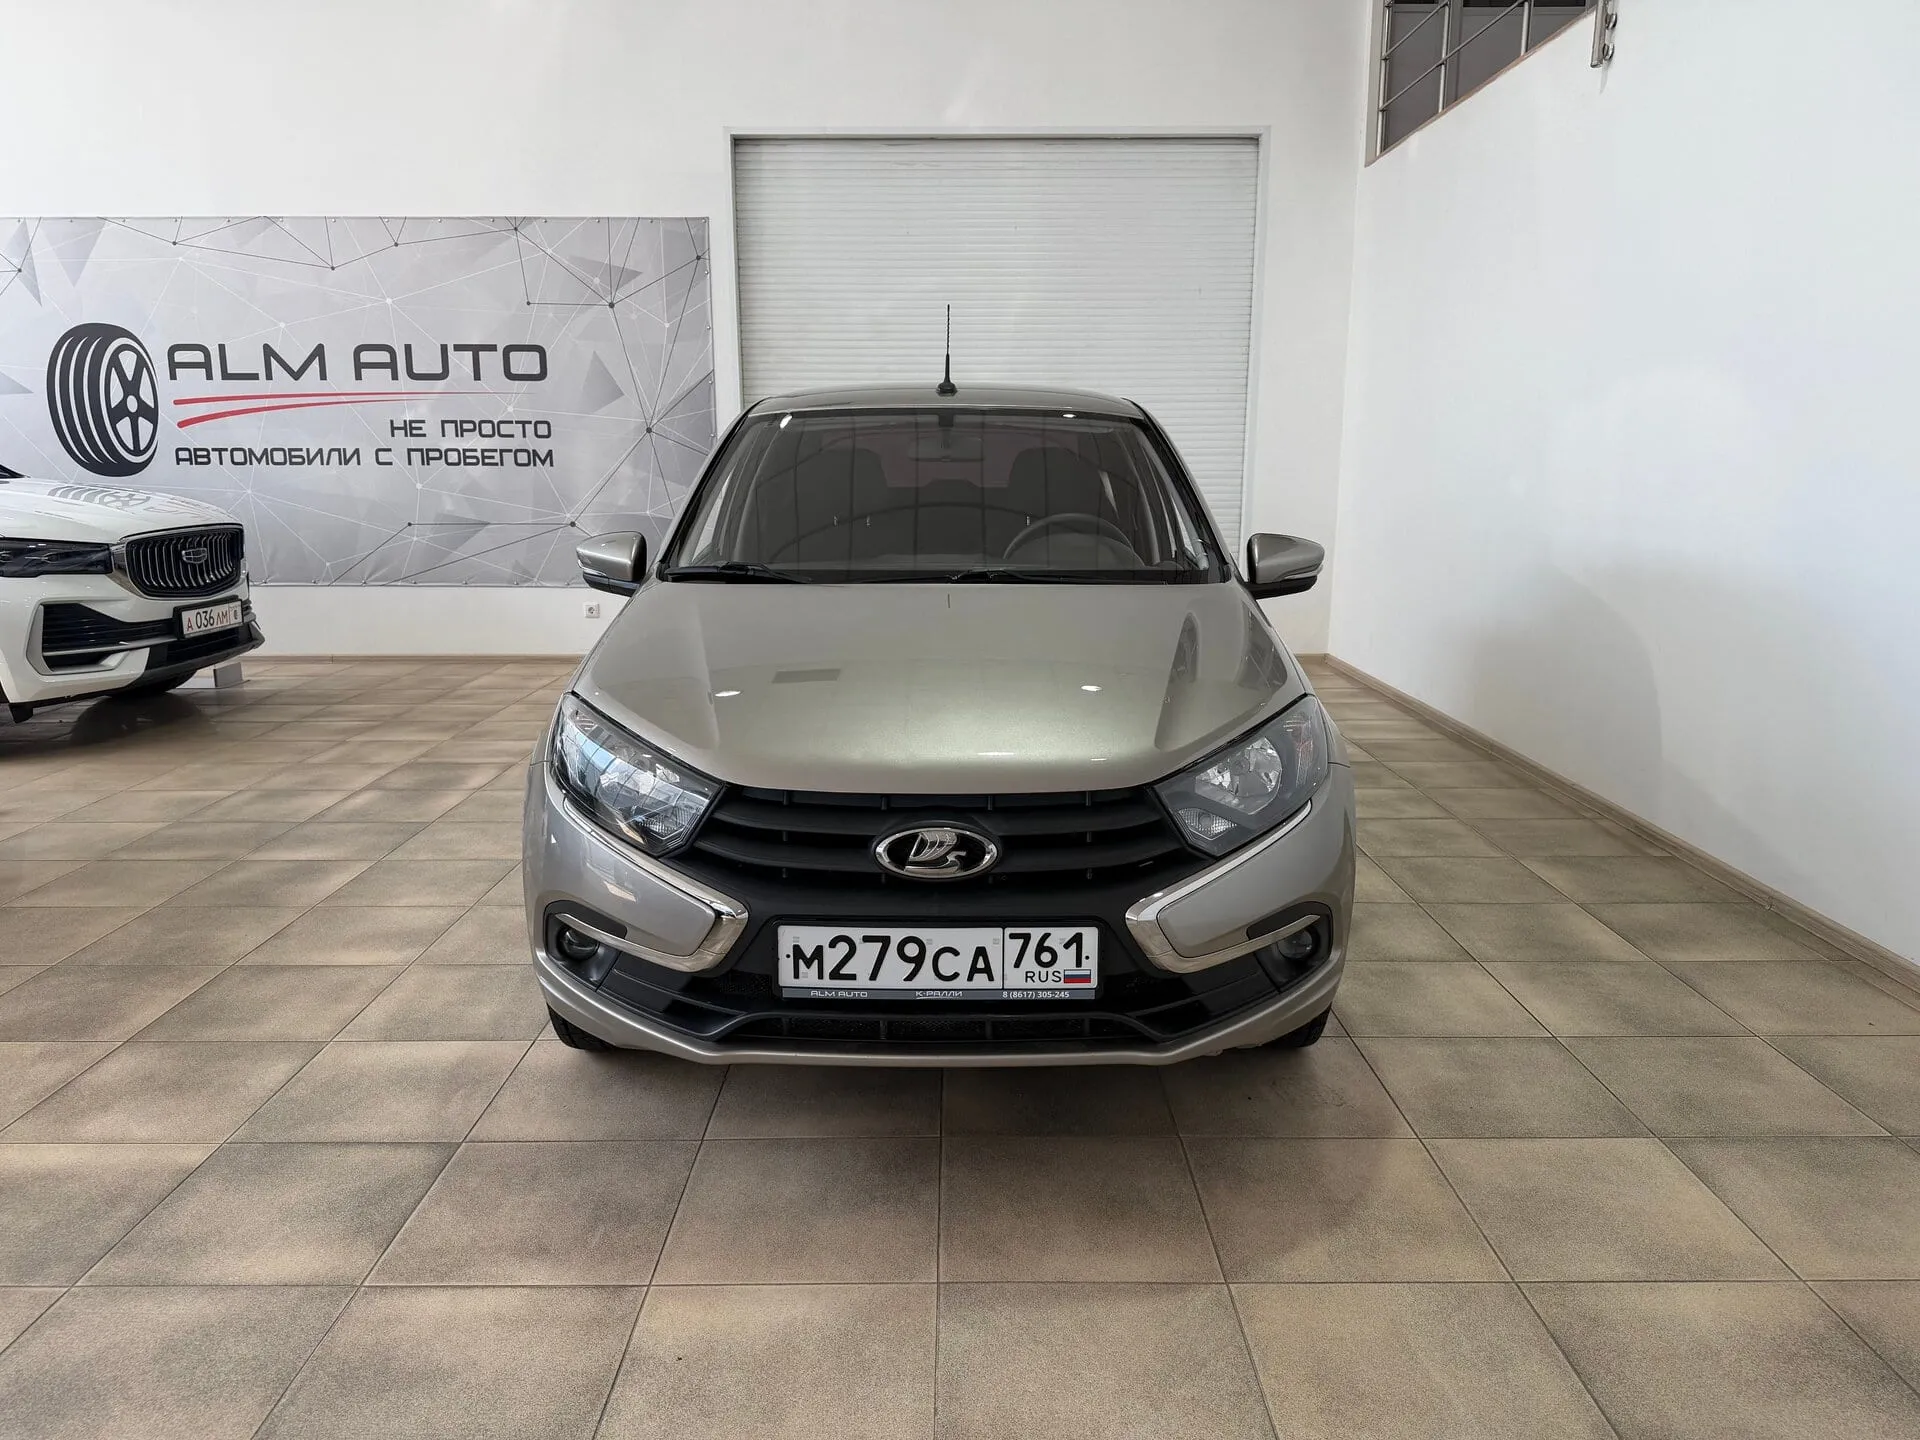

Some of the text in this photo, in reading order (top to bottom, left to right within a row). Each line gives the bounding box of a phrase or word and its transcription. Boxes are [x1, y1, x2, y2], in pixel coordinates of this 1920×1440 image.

[167, 343, 548, 382] ALM AUTO
[390, 419, 552, 439] НЕ ПРОСТО
[175, 447, 554, 468] АВТОМОБИЛИ С ПРОБЕГОМ
[792, 932, 1084, 982] М279СА 761
[1025, 970, 1062, 983] RUS
[838, 990, 868, 998] AUTO
[1002, 989, 1070, 999] 8 (8617) 305-245
